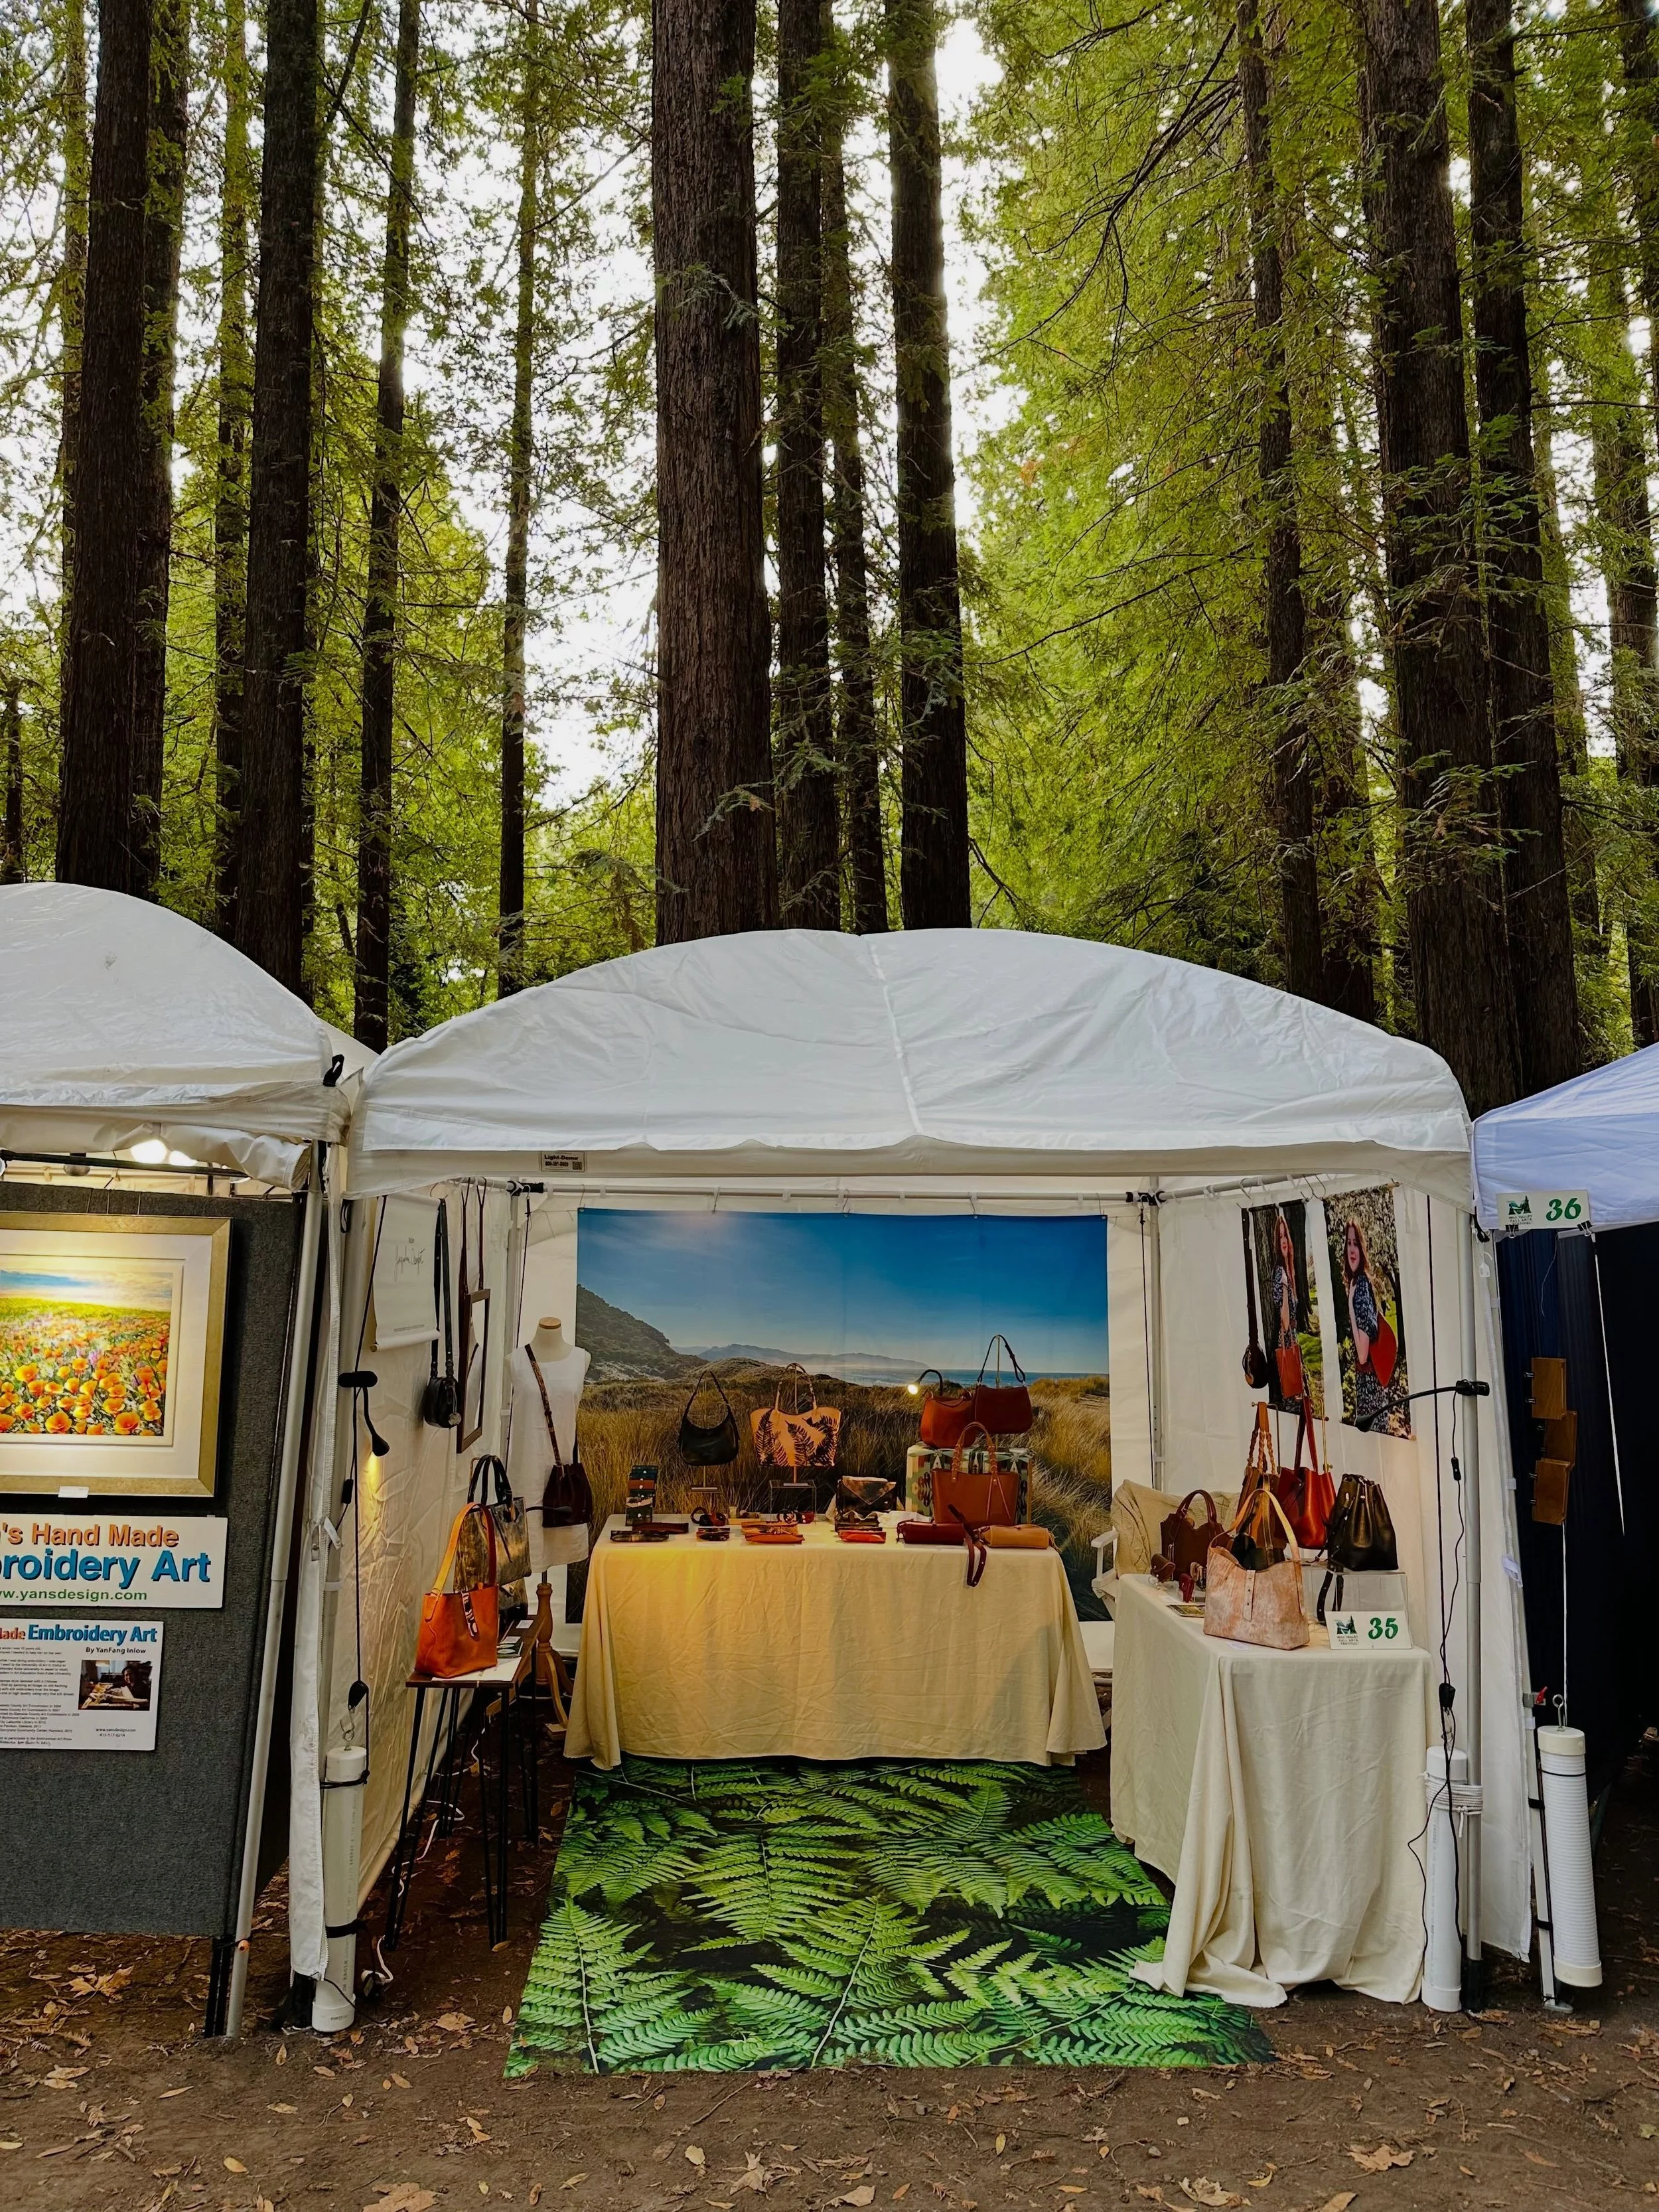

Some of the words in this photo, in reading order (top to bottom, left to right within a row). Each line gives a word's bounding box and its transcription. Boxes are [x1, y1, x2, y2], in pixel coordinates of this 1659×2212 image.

[1546, 1197, 1581, 1221] 36
[32, 1523, 100, 1546] Hand
[108, 1524, 179, 1547] Made
[0, 1548, 141, 1589] roidery
[151, 1550, 211, 1583] Art
[0, 1627, 26, 1640] ade
[28, 1624, 127, 1646] Embroidery
[130, 1626, 157, 1642] Art
[1368, 1617, 1398, 1639] 35
